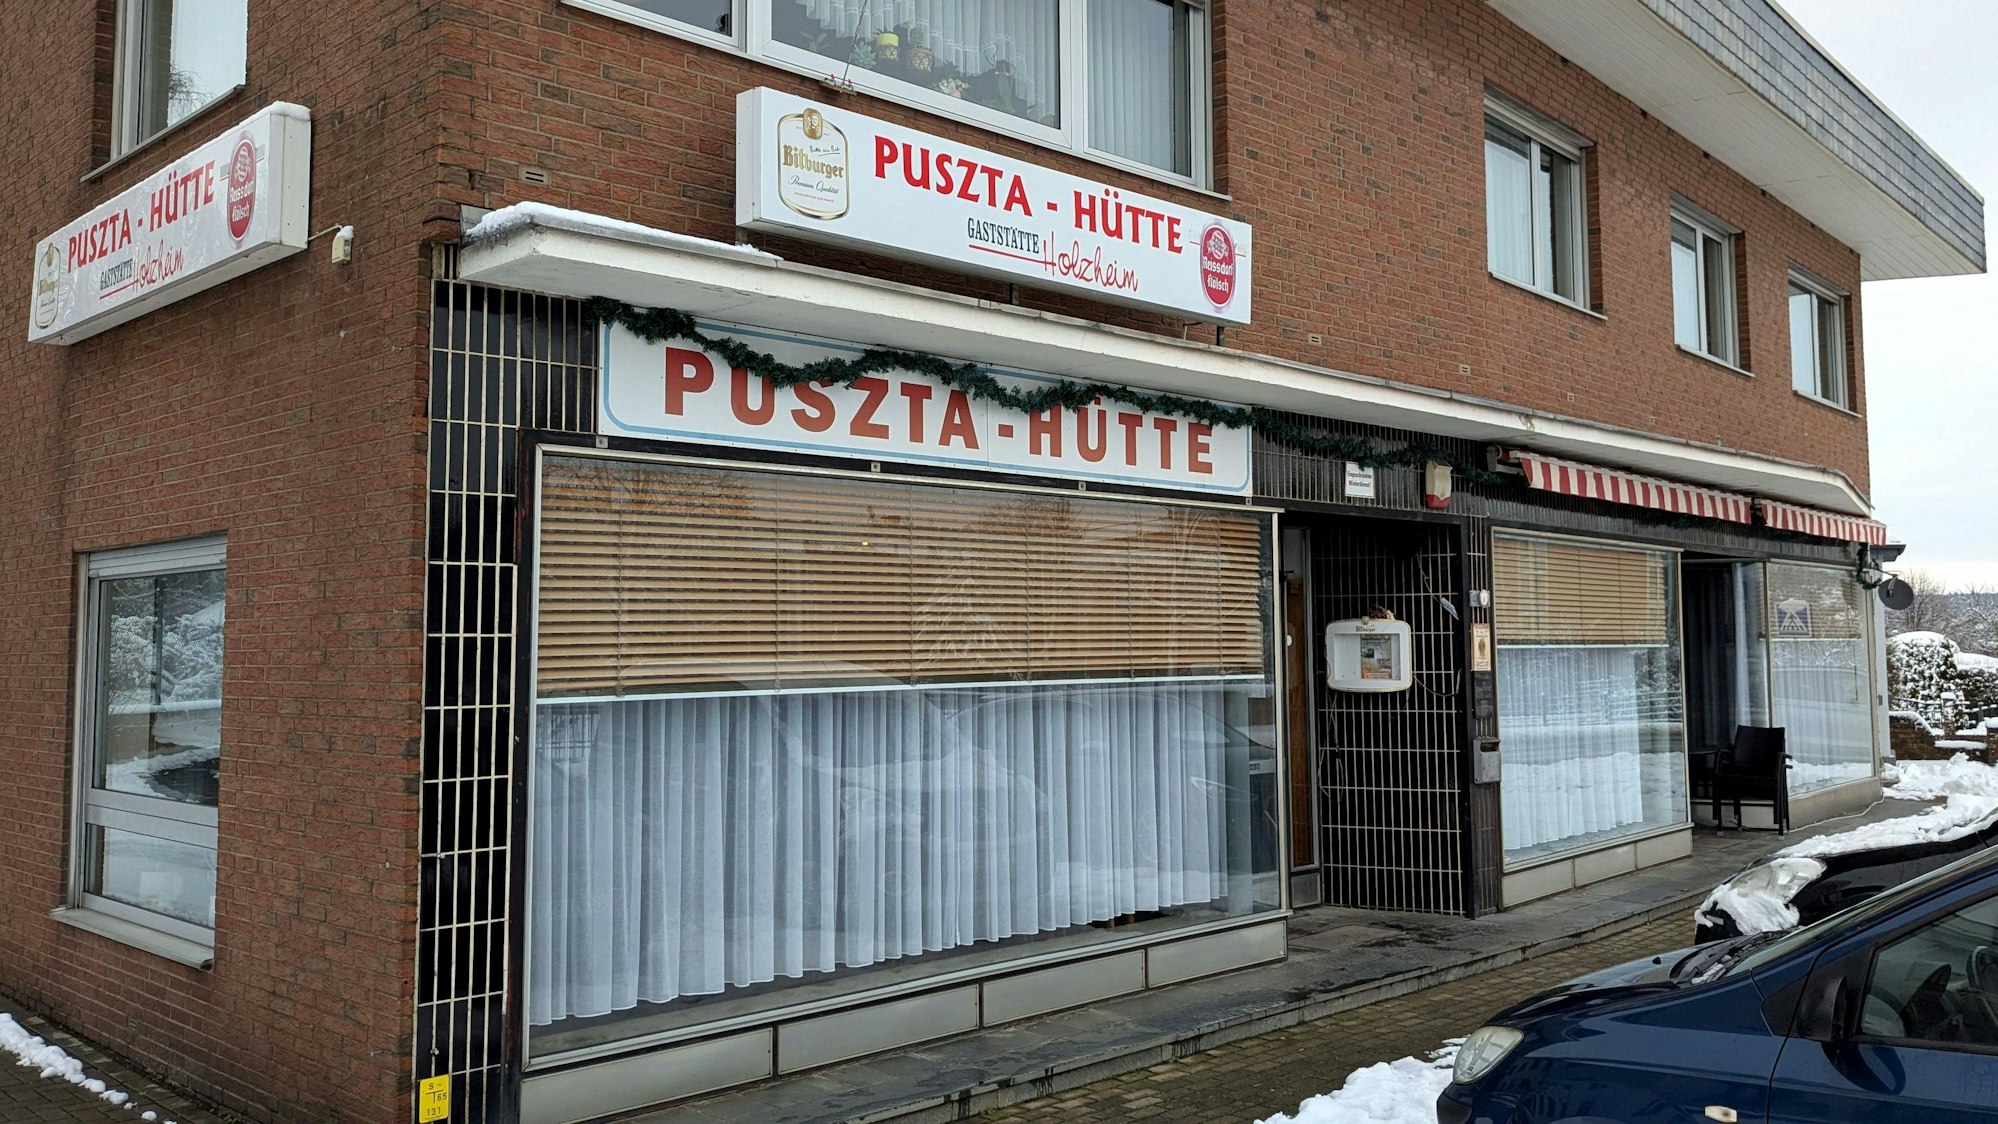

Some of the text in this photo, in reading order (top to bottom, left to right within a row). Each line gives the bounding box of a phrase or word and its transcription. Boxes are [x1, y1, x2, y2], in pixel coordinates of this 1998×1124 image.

[782, 144, 844, 179] Bitburger
[788, 175, 814, 189] Premium
[67, 208, 132, 273] PUSZTA
[149, 159, 216, 233] HÜTTE
[874, 136, 1034, 217] PUSZTA
[1073, 189, 1185, 255] HÜTTE
[100, 239, 185, 293] GASTSTÄTTE Holzheim
[967, 217, 1139, 293] GASTSTÄTTE Holzheim
